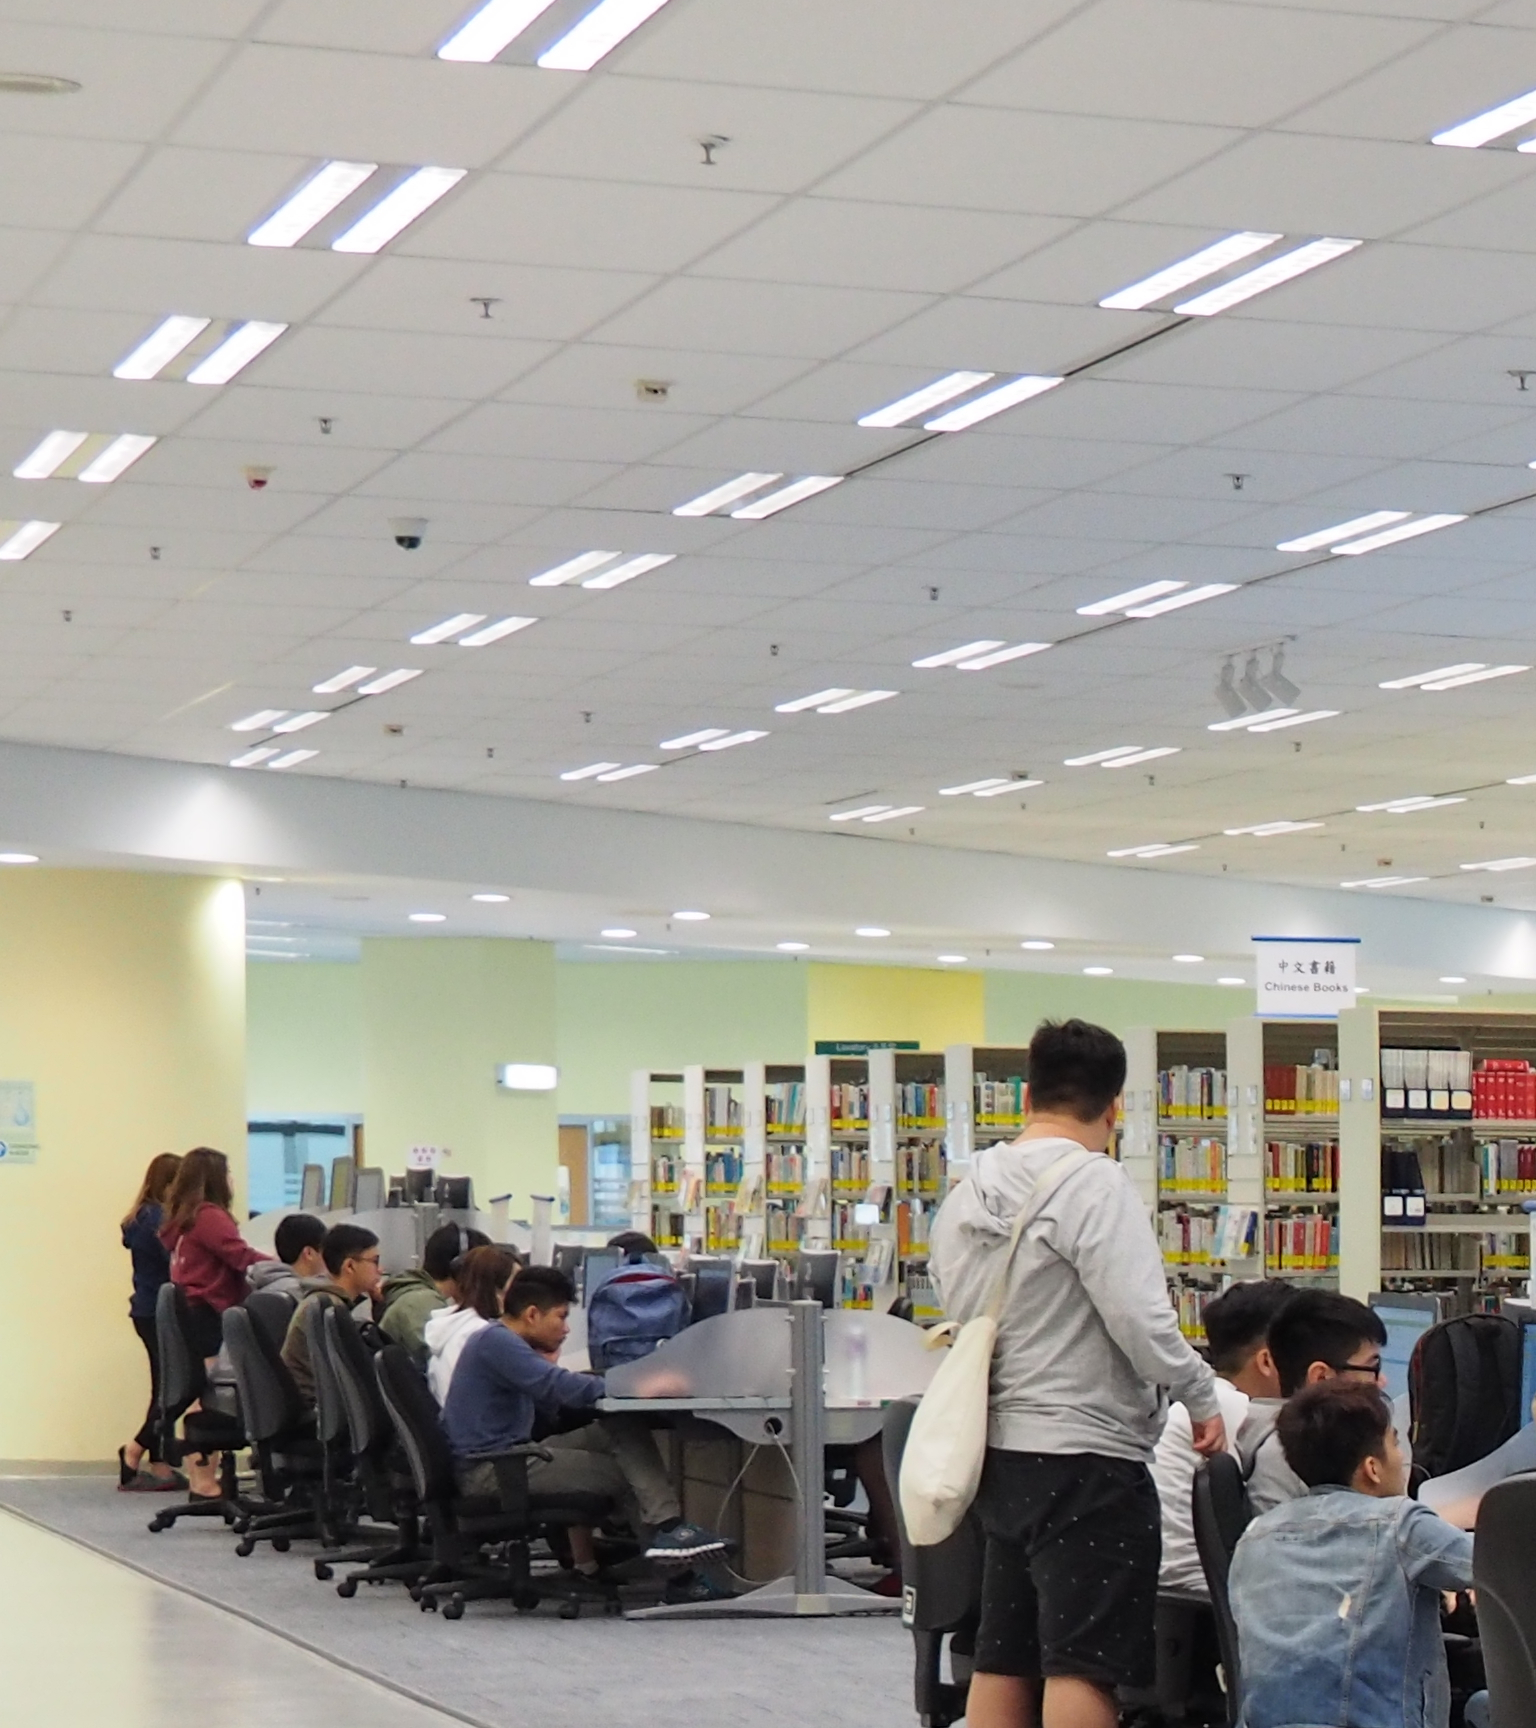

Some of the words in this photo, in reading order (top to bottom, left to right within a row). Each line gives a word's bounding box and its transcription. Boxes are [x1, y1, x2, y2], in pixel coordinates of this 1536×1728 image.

[1279, 959, 1336, 975] 中文書籍
[1264, 982, 1310, 992] Chinese
[1313, 982, 1349, 993] Books
